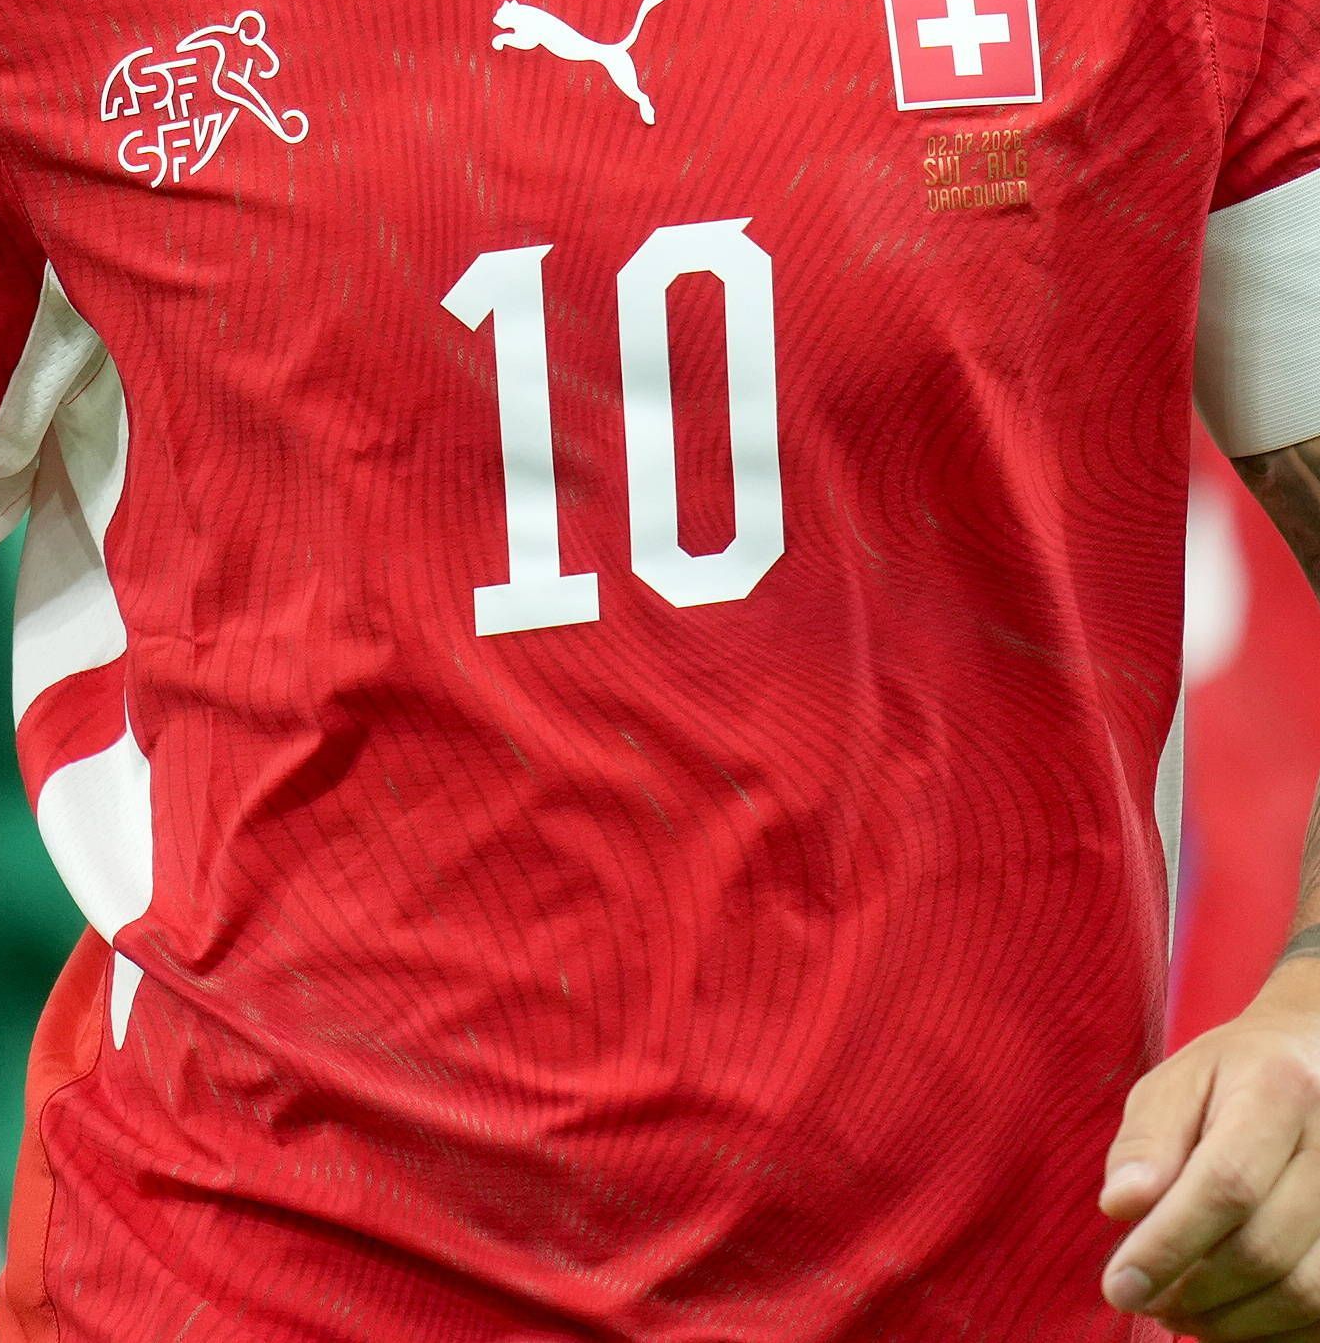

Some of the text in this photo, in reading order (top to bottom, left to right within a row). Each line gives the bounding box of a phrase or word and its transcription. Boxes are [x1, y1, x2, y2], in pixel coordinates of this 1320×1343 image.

[927, 130, 1022, 157] 02.07.2026
[923, 155, 962, 186] SUI
[987, 150, 1028, 179] ALG
[927, 180, 1028, 213] VANCOUVER
[439, 216, 786, 638] 10
